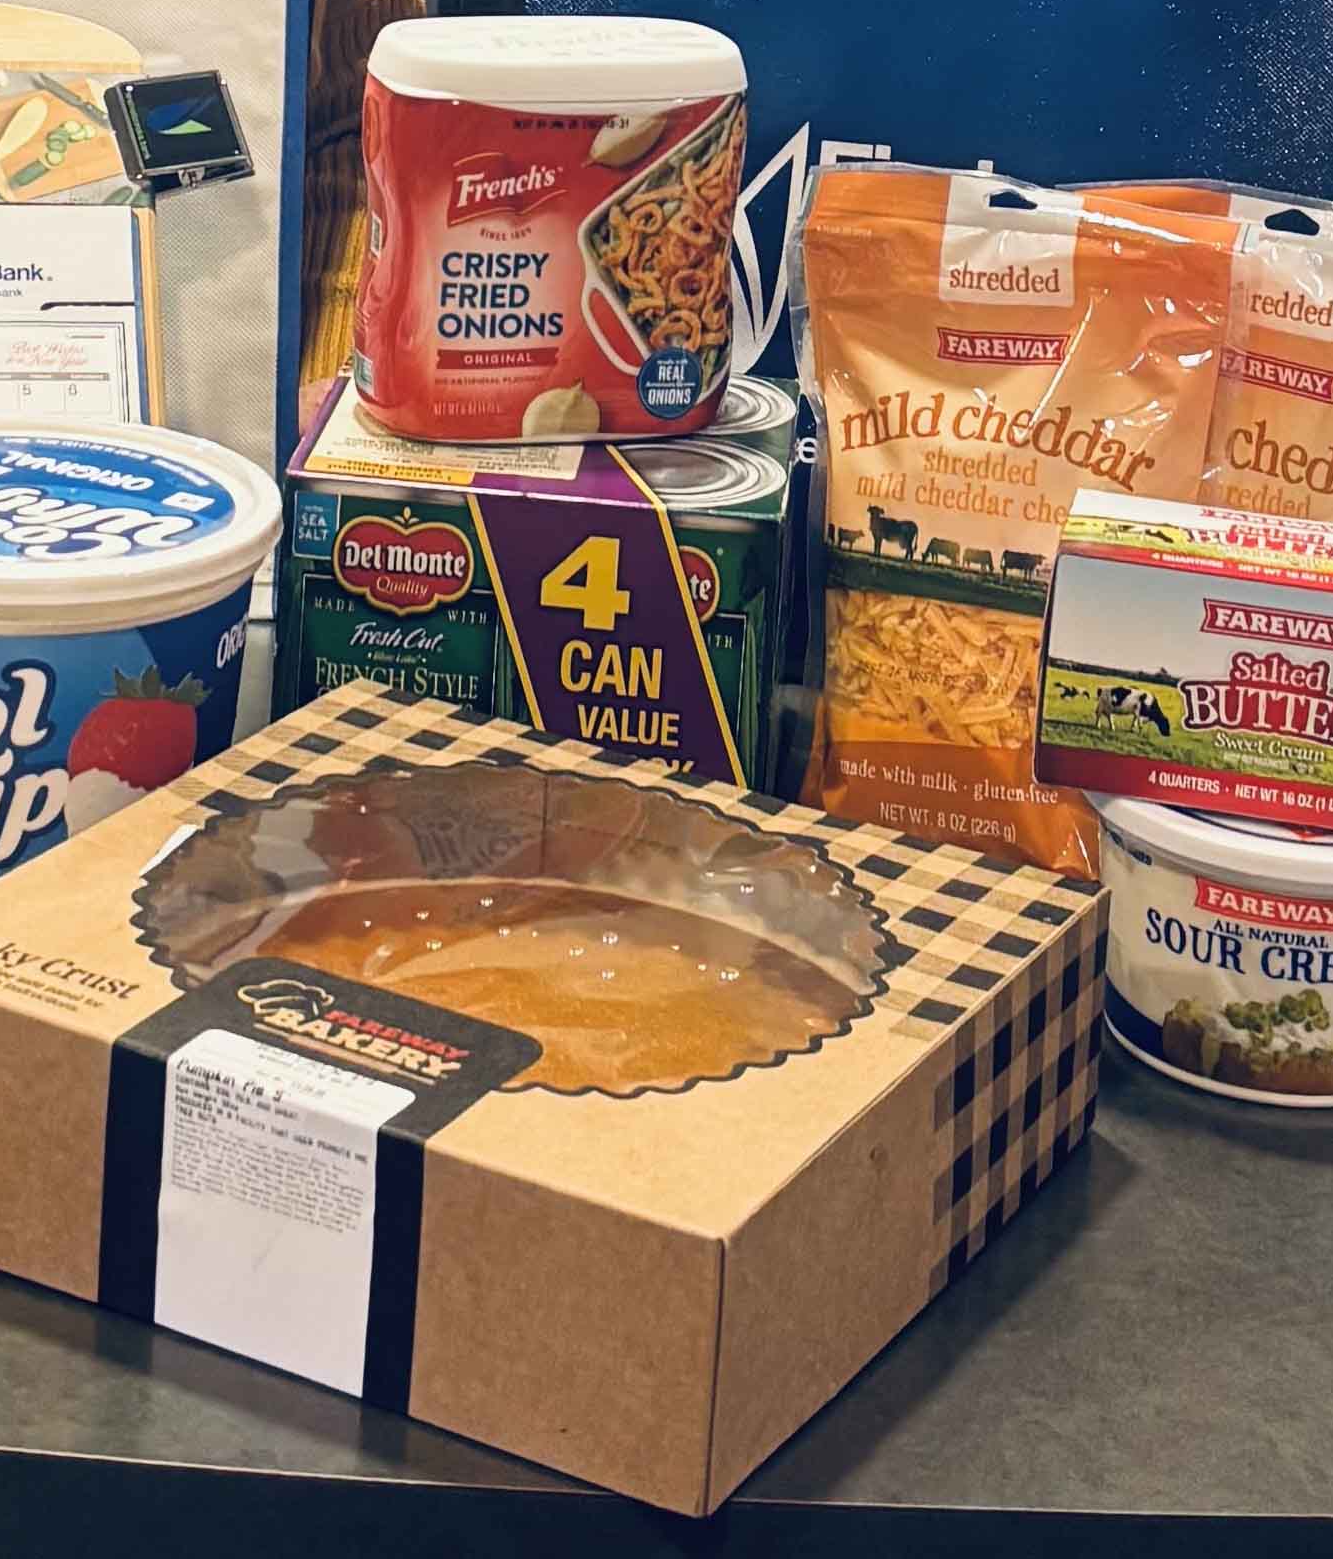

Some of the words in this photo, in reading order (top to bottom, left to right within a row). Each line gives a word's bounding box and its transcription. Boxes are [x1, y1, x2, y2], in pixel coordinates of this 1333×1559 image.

[456, 163, 556, 208] French's
[442, 252, 550, 279] CRISPY
[948, 260, 1061, 293] shredded
[440, 282, 530, 309] FRIED
[437, 312, 565, 339] ONIONS
[463, 353, 533, 365] ORIGINAL
[946, 336, 1061, 359] FAREWAY
[658, 365, 684, 381] REAL
[1220, 352, 1329, 396] FAREWAY
[648, 388, 692, 405] ONIONS
[841, 392, 945, 453] mild
[952, 393, 1156, 492] cheddar
[2, 450, 154, 491] ORIGINAL
[923, 445, 1038, 488] shredded
[857, 472, 908, 502] mild
[914, 477, 1015, 520] cheddar
[298, 527, 329, 541] SALT
[301, 513, 327, 527] SEA
[344, 541, 382, 571] Del
[386, 544, 467, 577] Monte
[376, 576, 429, 598] Quality
[540, 536, 630, 631] 4
[314, 596, 356, 613] MADE
[447, 609, 487, 625] WITH
[403, 627, 444, 650] Cut
[412, 667, 479, 700] STYLE
[560, 640, 663, 701] CAN
[1234, 655, 1327, 692] Salted
[578, 704, 681, 747] VALUE
[1214, 731, 1266, 755] Sweet
[1269, 738, 1326, 763] Cream
[840, 759, 877, 780] made
[883, 765, 916, 787] with
[922, 770, 958, 794] milk
[973, 778, 1059, 805] gluten-free
[1148, 770, 1157, 784] 4
[1159, 772, 1221, 795] QUARTERS
[1235, 784, 1257, 800] NET
[1259, 788, 1278, 803] WT
[1282, 791, 1295, 807] 16
[1297, 794, 1314, 810] OZ
[879, 801, 907, 822] NET
[908, 806, 934, 827] WT.
[937, 812, 946, 829] 8
[951, 815, 967, 833] OZ
[1145, 907, 1246, 975] SOUR
[1212, 919, 1244, 939] ALL
[1247, 926, 1330, 950] NATURAL
[39, 957, 141, 1000] Crust
[263, 1006, 462, 1079] BAKERY
[324, 1009, 470, 1061] FAREWAY
[176, 1057, 236, 1088] Pumpkin
